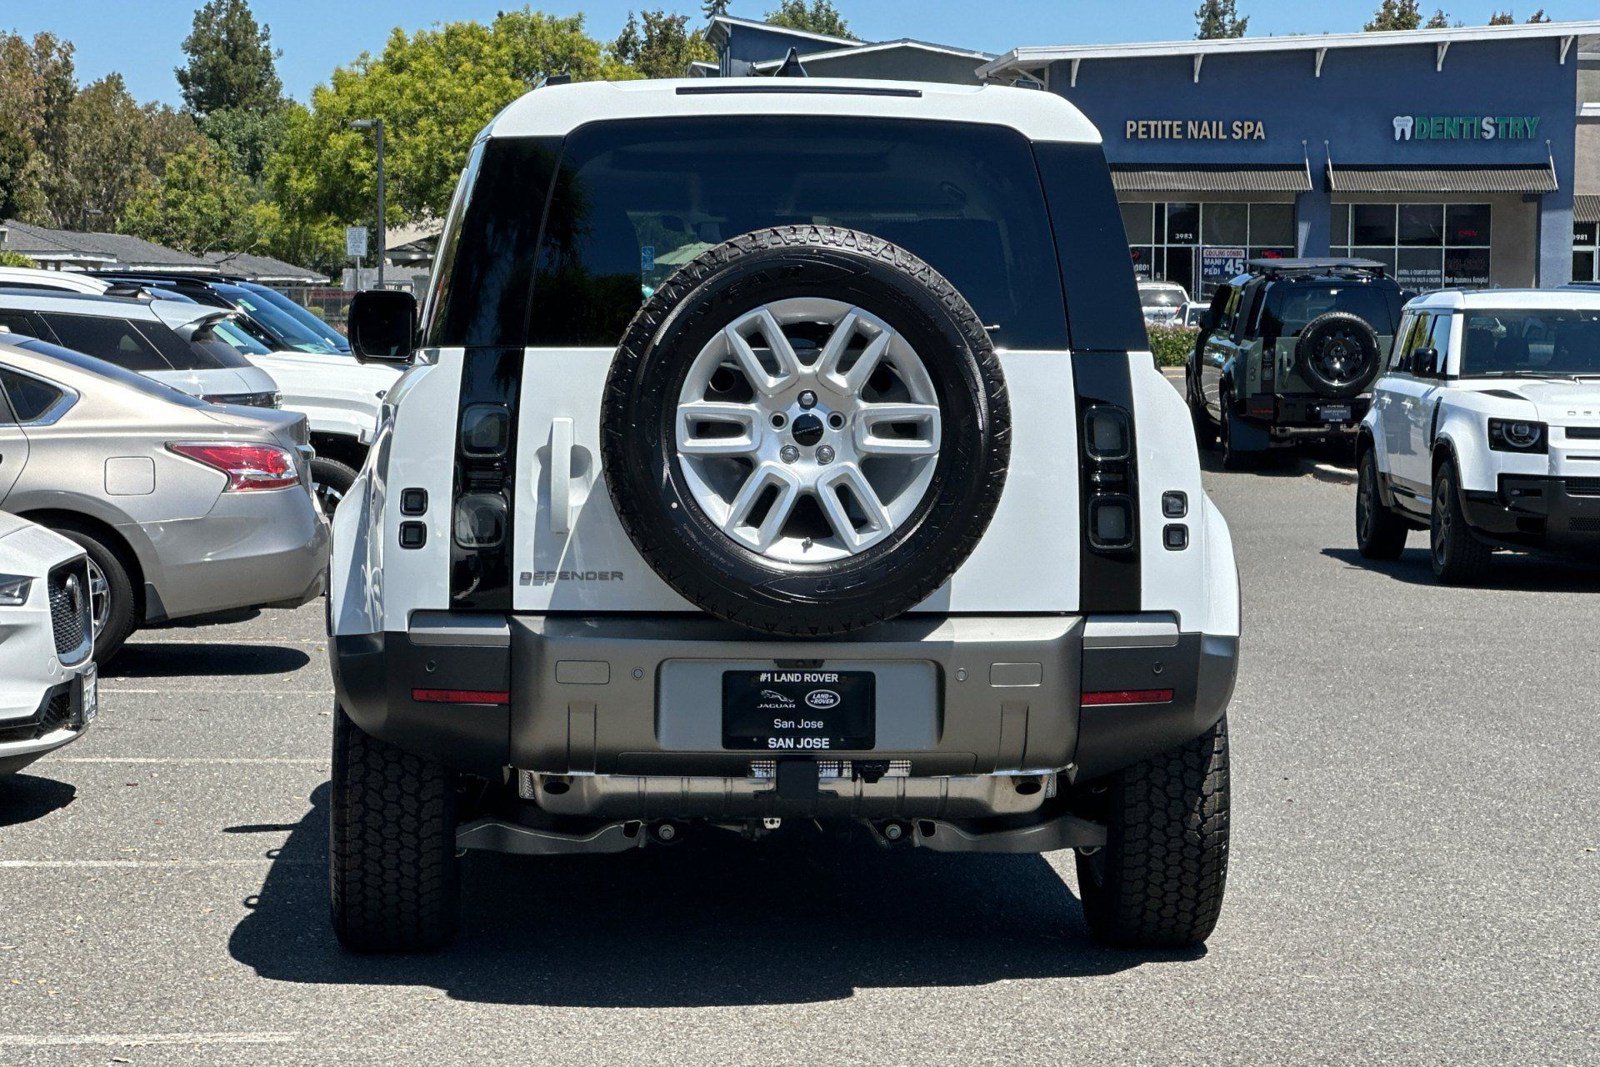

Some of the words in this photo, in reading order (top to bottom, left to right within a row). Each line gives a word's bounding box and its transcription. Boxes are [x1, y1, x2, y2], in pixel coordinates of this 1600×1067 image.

[1126, 120, 1183, 139] PETITE
[1187, 120, 1227, 139] NAIL
[1231, 120, 1266, 140] SPA
[1414, 116, 1540, 140] DENTISTRY
[1204, 258, 1222, 266] MANI
[1204, 267, 1221, 276] PEDI
[519, 570, 625, 582] DEFENDER
[760, 673, 772, 682] #1
[774, 673, 801, 683] LAND
[804, 673, 839, 683] ROVER
[773, 719, 795, 729] San
[797, 718, 824, 729] Jose
[768, 738, 794, 749] SAN
[796, 738, 830, 749] JOSE
